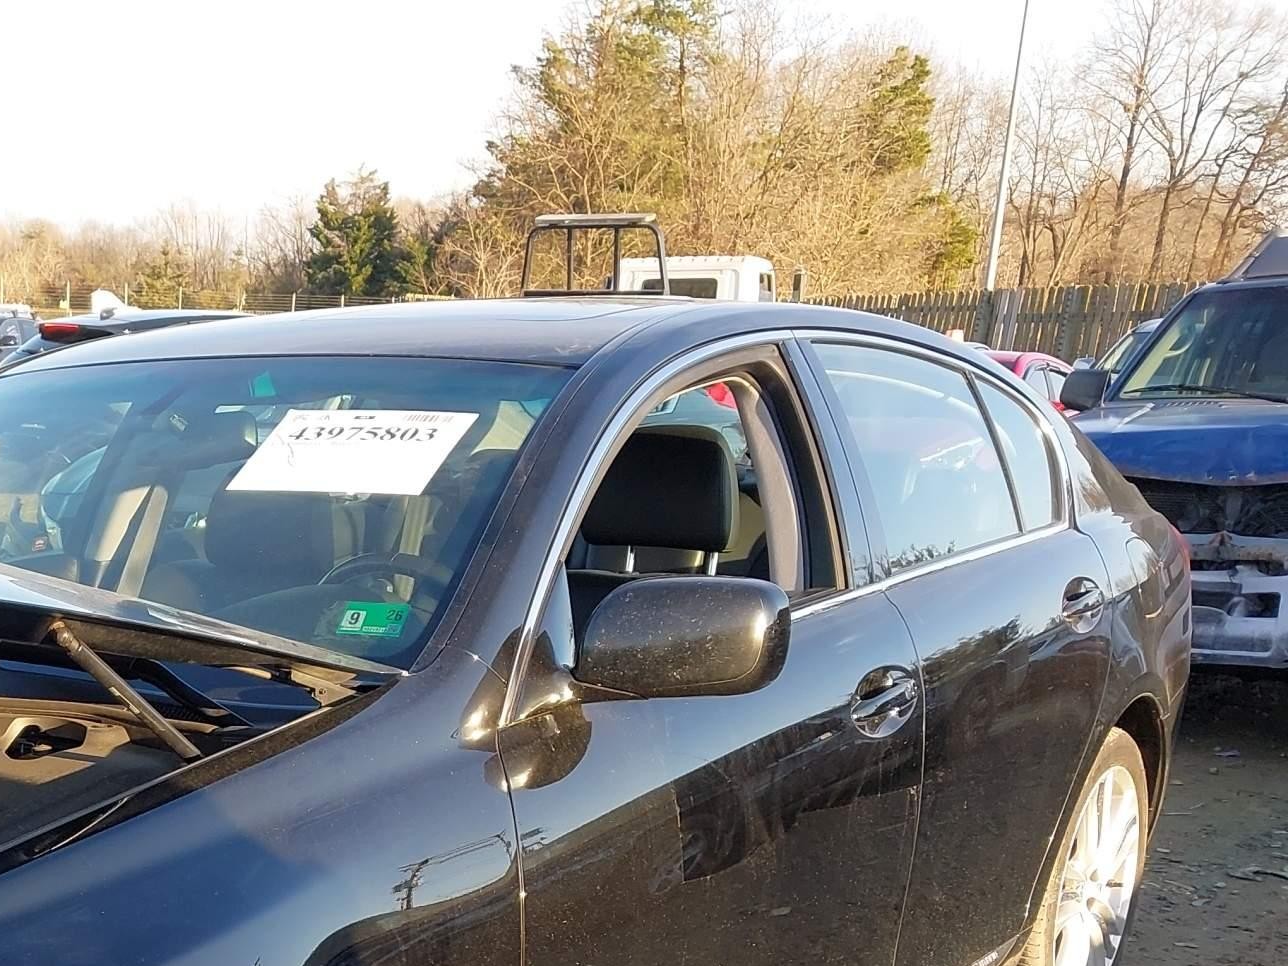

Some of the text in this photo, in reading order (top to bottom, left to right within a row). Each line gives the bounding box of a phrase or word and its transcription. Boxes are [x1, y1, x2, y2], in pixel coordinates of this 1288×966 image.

[288, 426, 438, 441] 43975803
[348, 611, 361, 625] 9
[387, 609, 403, 621] 26
